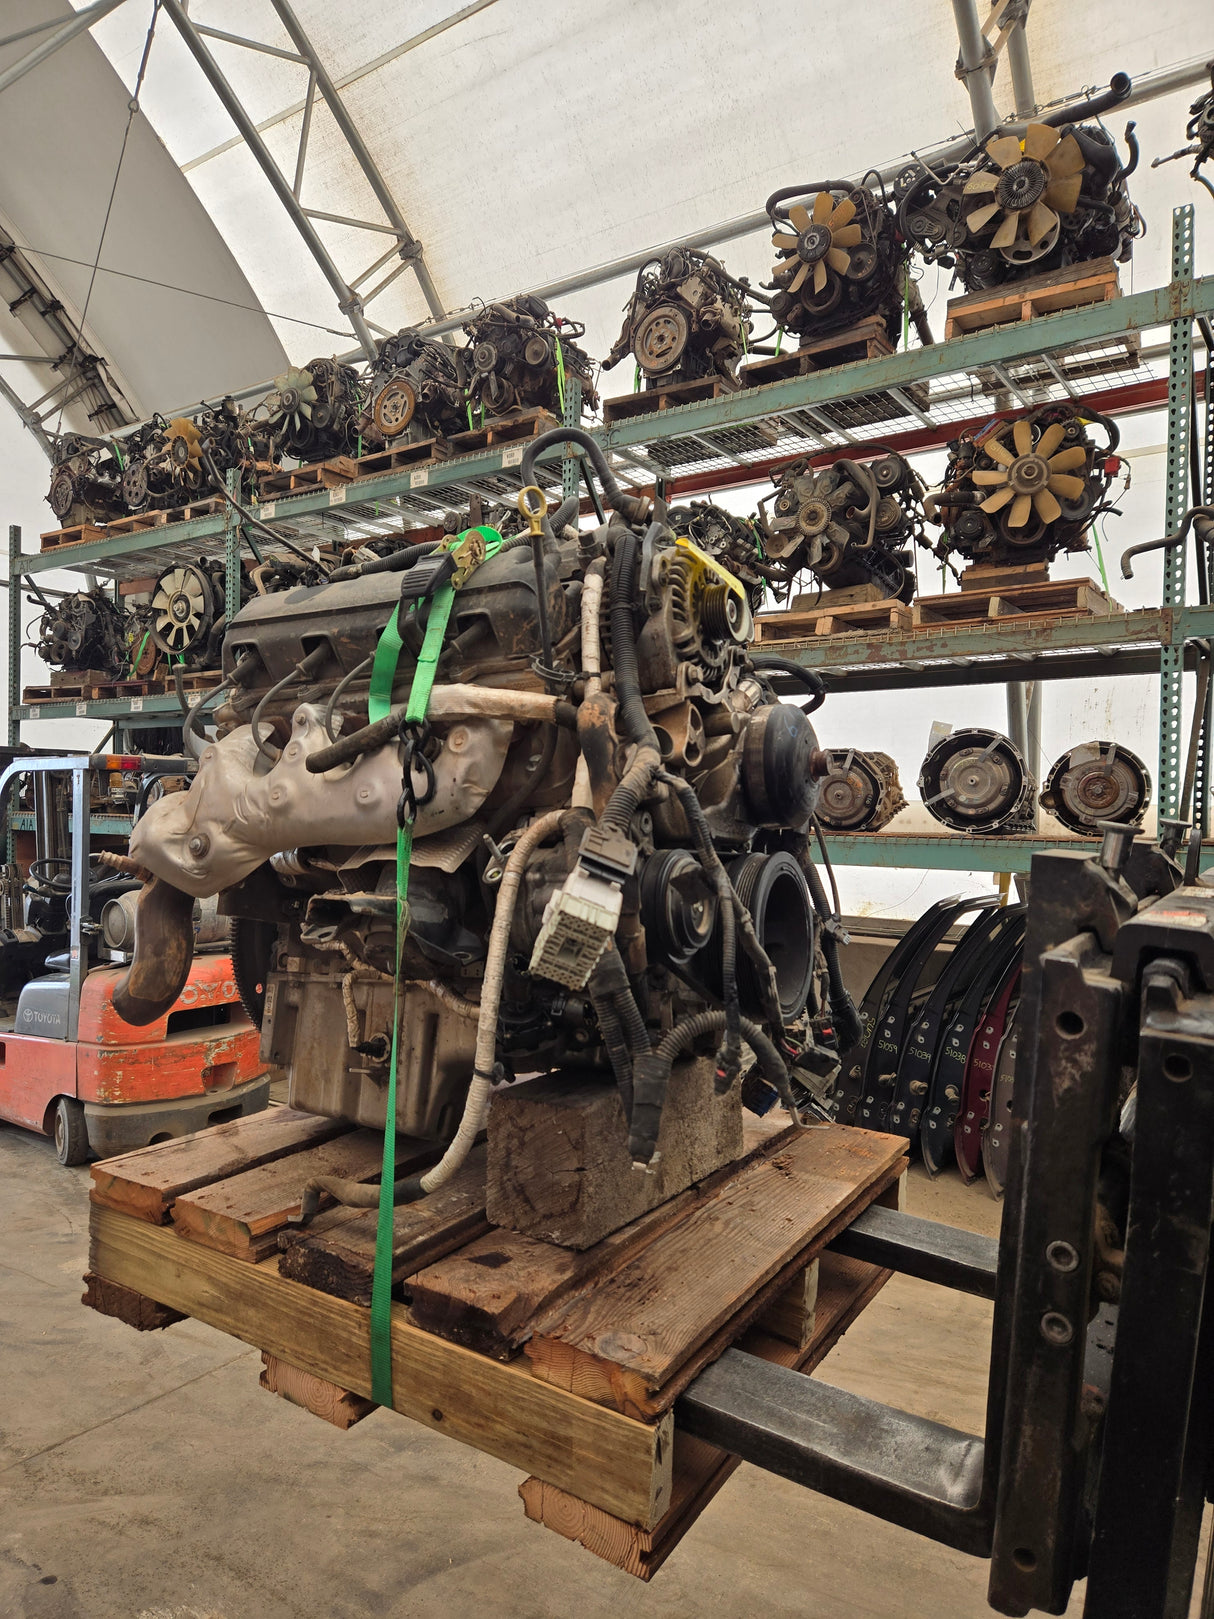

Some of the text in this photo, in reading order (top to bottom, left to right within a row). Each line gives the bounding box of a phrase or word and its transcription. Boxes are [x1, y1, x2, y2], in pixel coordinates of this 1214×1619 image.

[34, 1011, 61, 1025] TOYOTA
[944, 1046, 966, 1064] 51038
[973, 1058, 994, 1071] 5103
